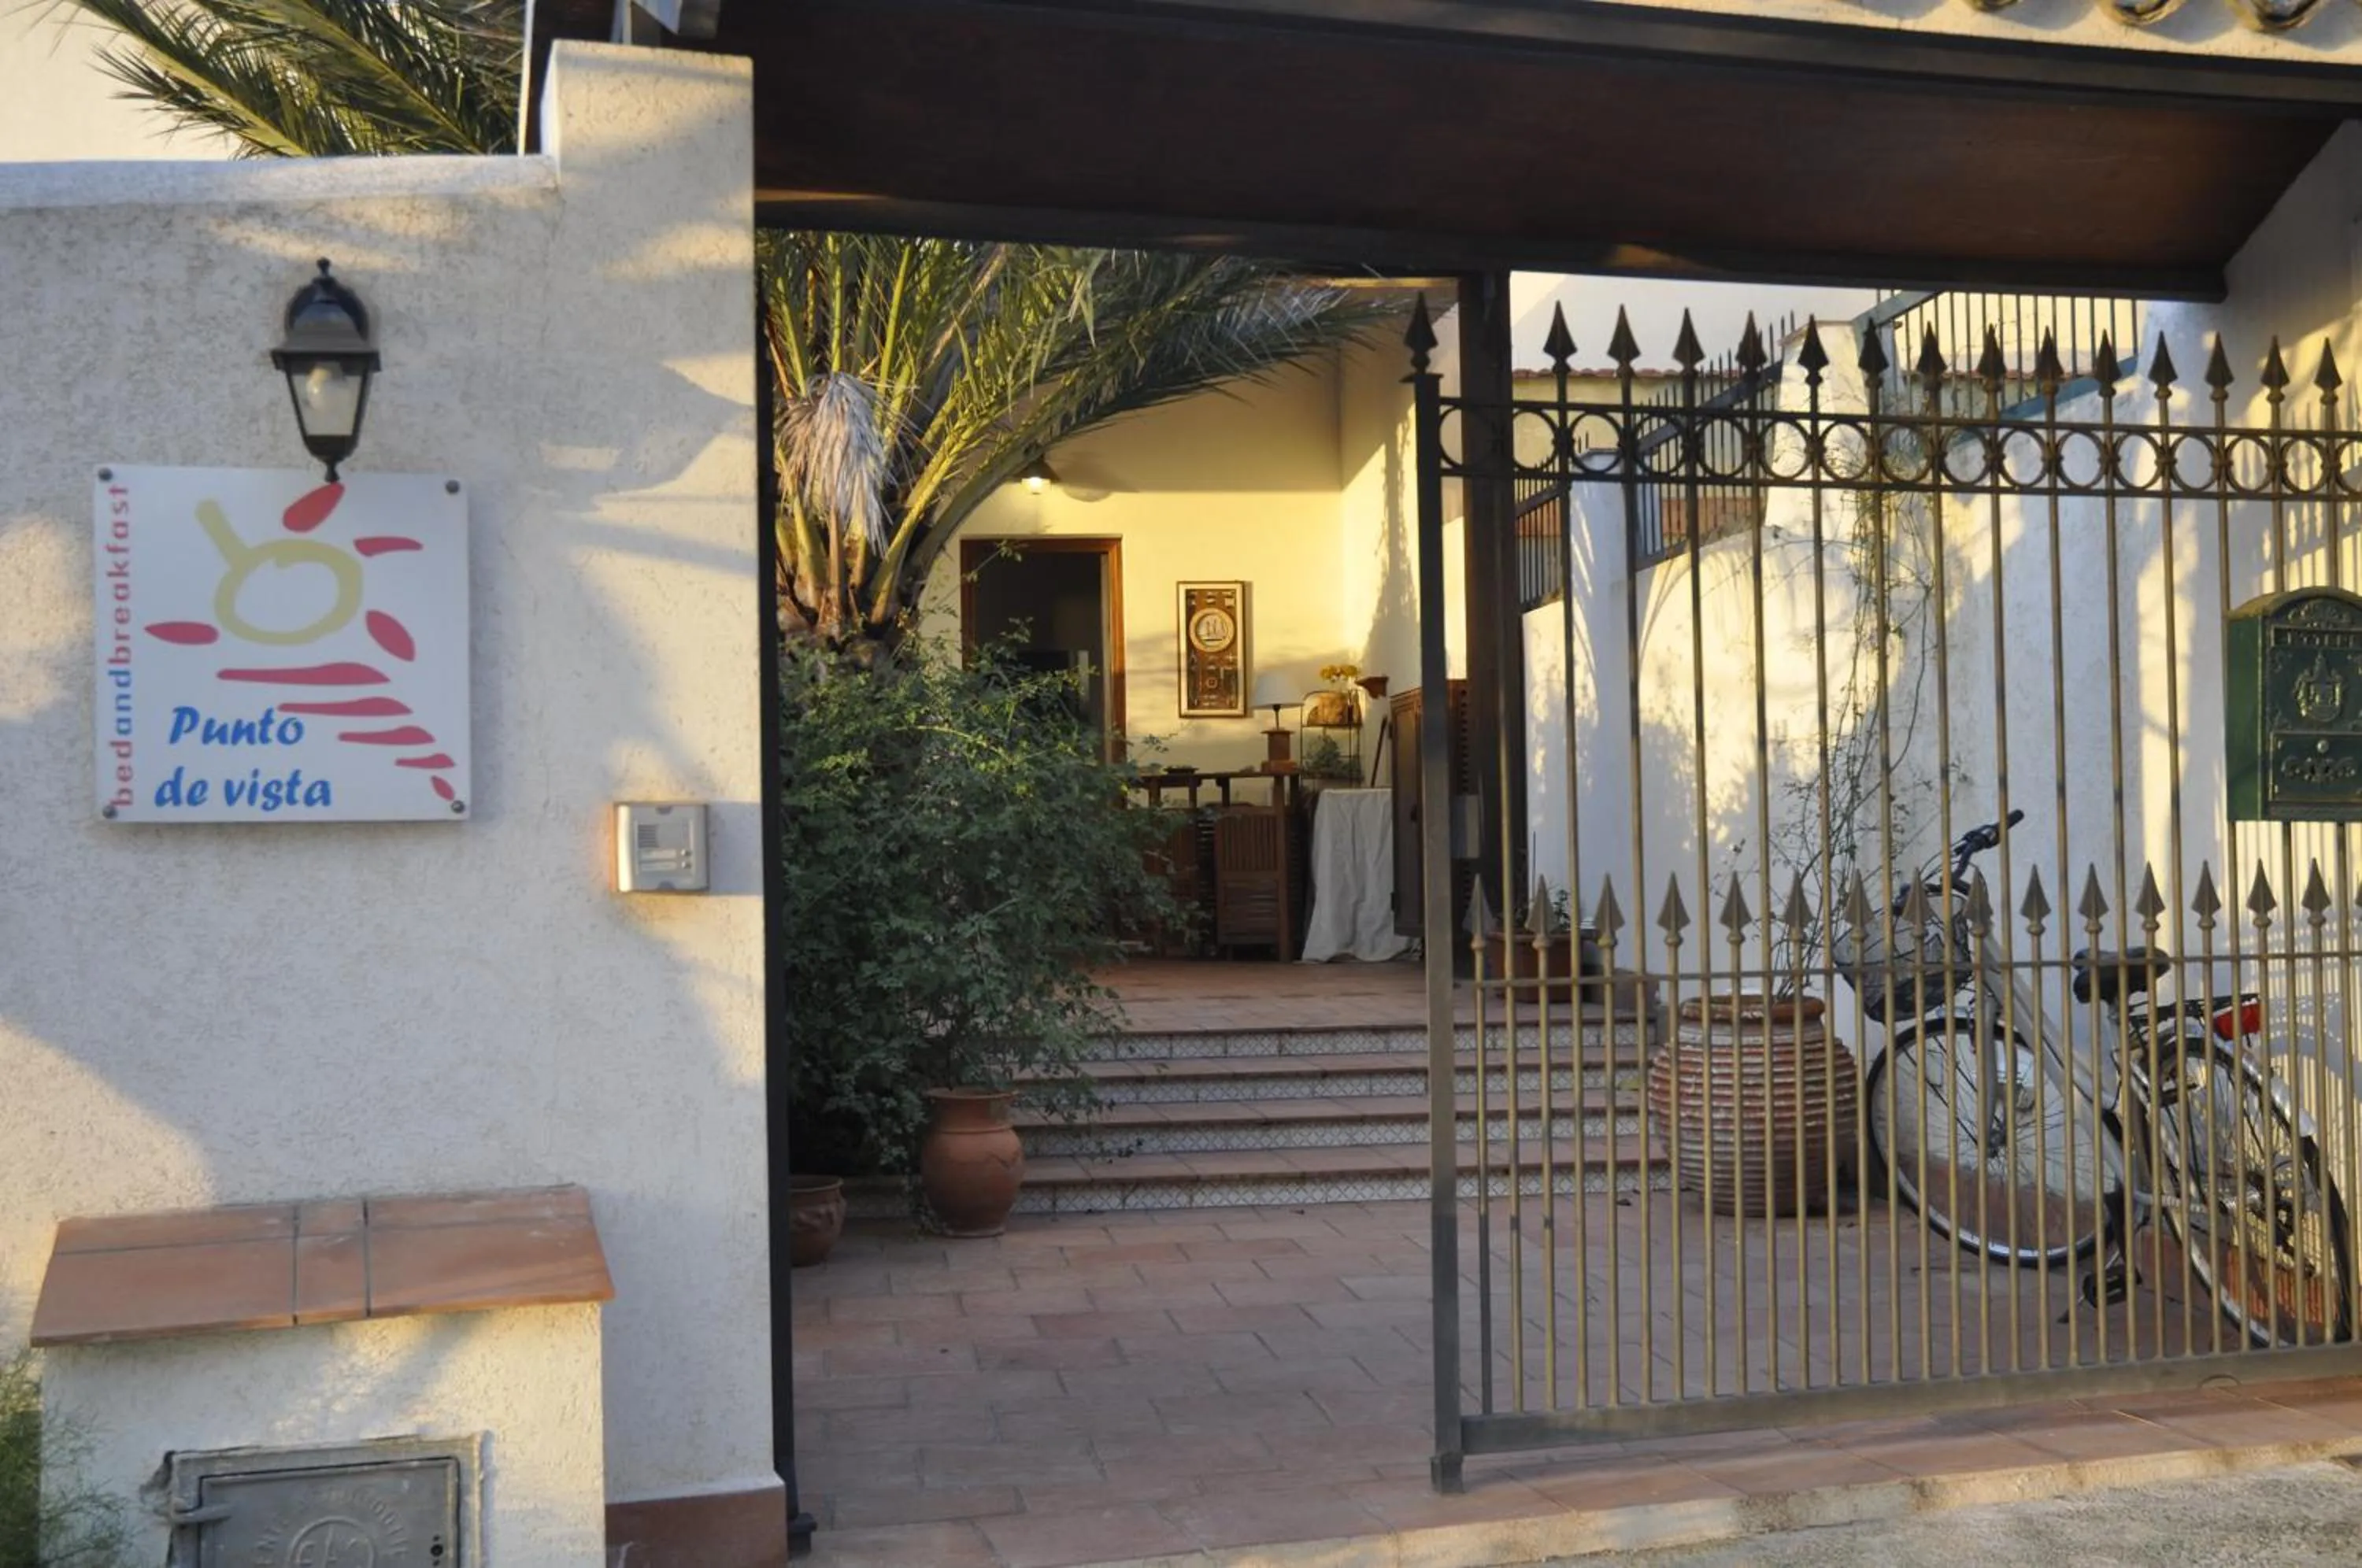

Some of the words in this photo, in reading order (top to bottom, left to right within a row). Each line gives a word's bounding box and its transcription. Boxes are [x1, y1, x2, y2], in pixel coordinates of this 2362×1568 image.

[168, 705, 305, 745] Punto
[154, 765, 209, 807] de
[224, 767, 331, 812] vista
